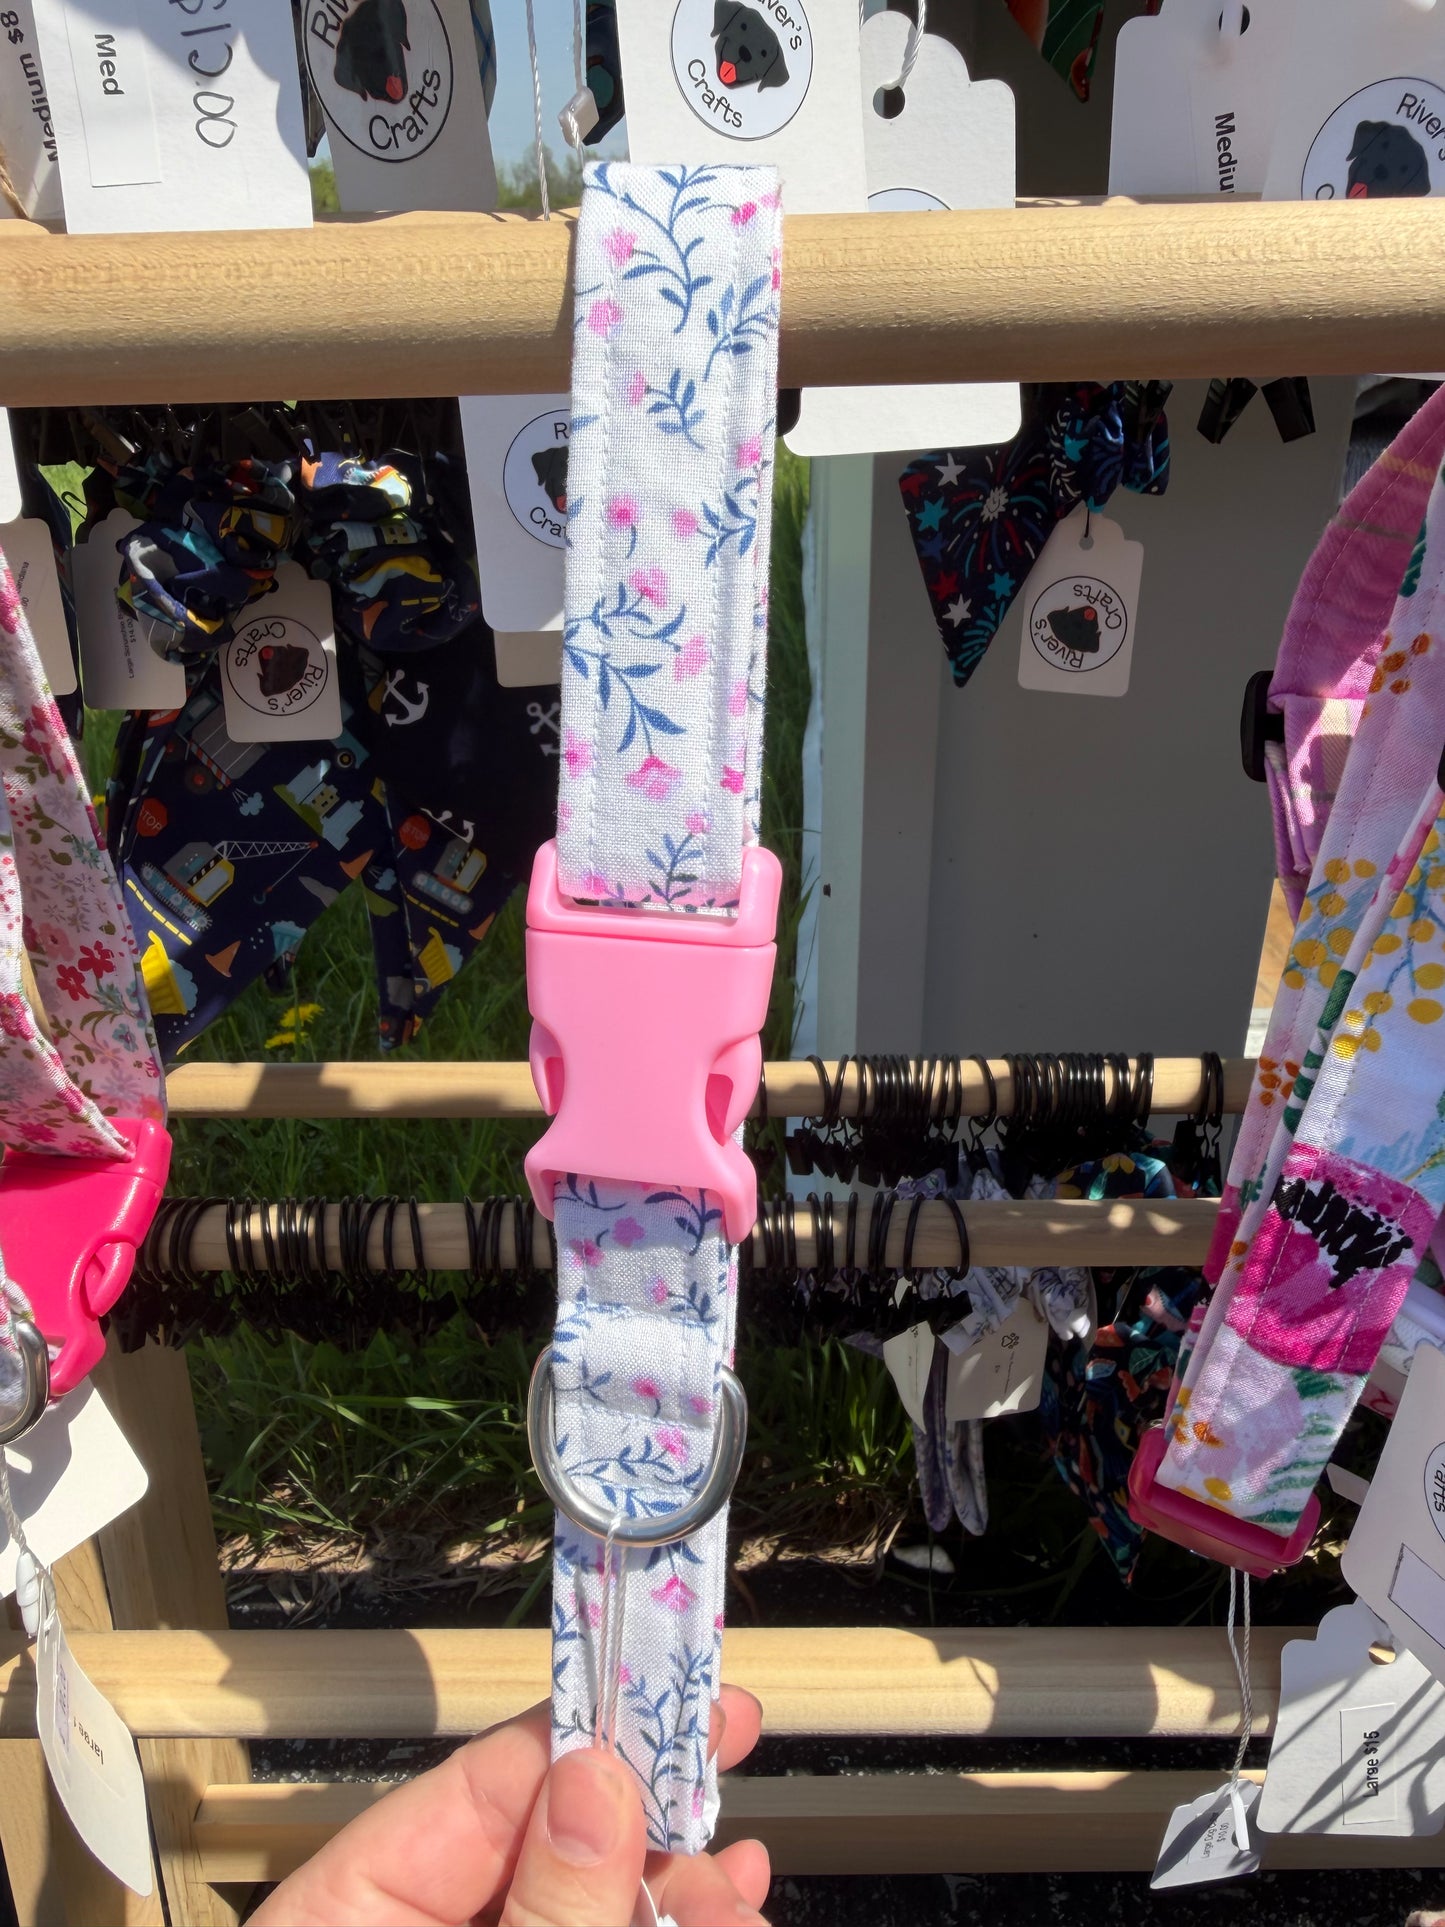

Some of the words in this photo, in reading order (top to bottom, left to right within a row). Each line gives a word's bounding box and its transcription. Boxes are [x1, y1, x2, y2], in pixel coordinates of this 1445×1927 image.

[0, 9, 25, 45] $8
[94, 33, 125, 96] Med
[18, 52, 59, 163] Medium
[368, 68, 442, 150] Crafts
[687, 58, 743, 129] Crafts
[1214, 111, 1240, 194] Mediu
[1072, 583, 1122, 630] Crafts
[234, 621, 286, 667] Crafts
[1034, 617, 1085, 669] River's
[267, 663, 325, 713] River's
[142, 808, 163, 831] TOP
[1363, 1730, 1380, 1755] $15
[1362, 1758, 1380, 1798] Large
